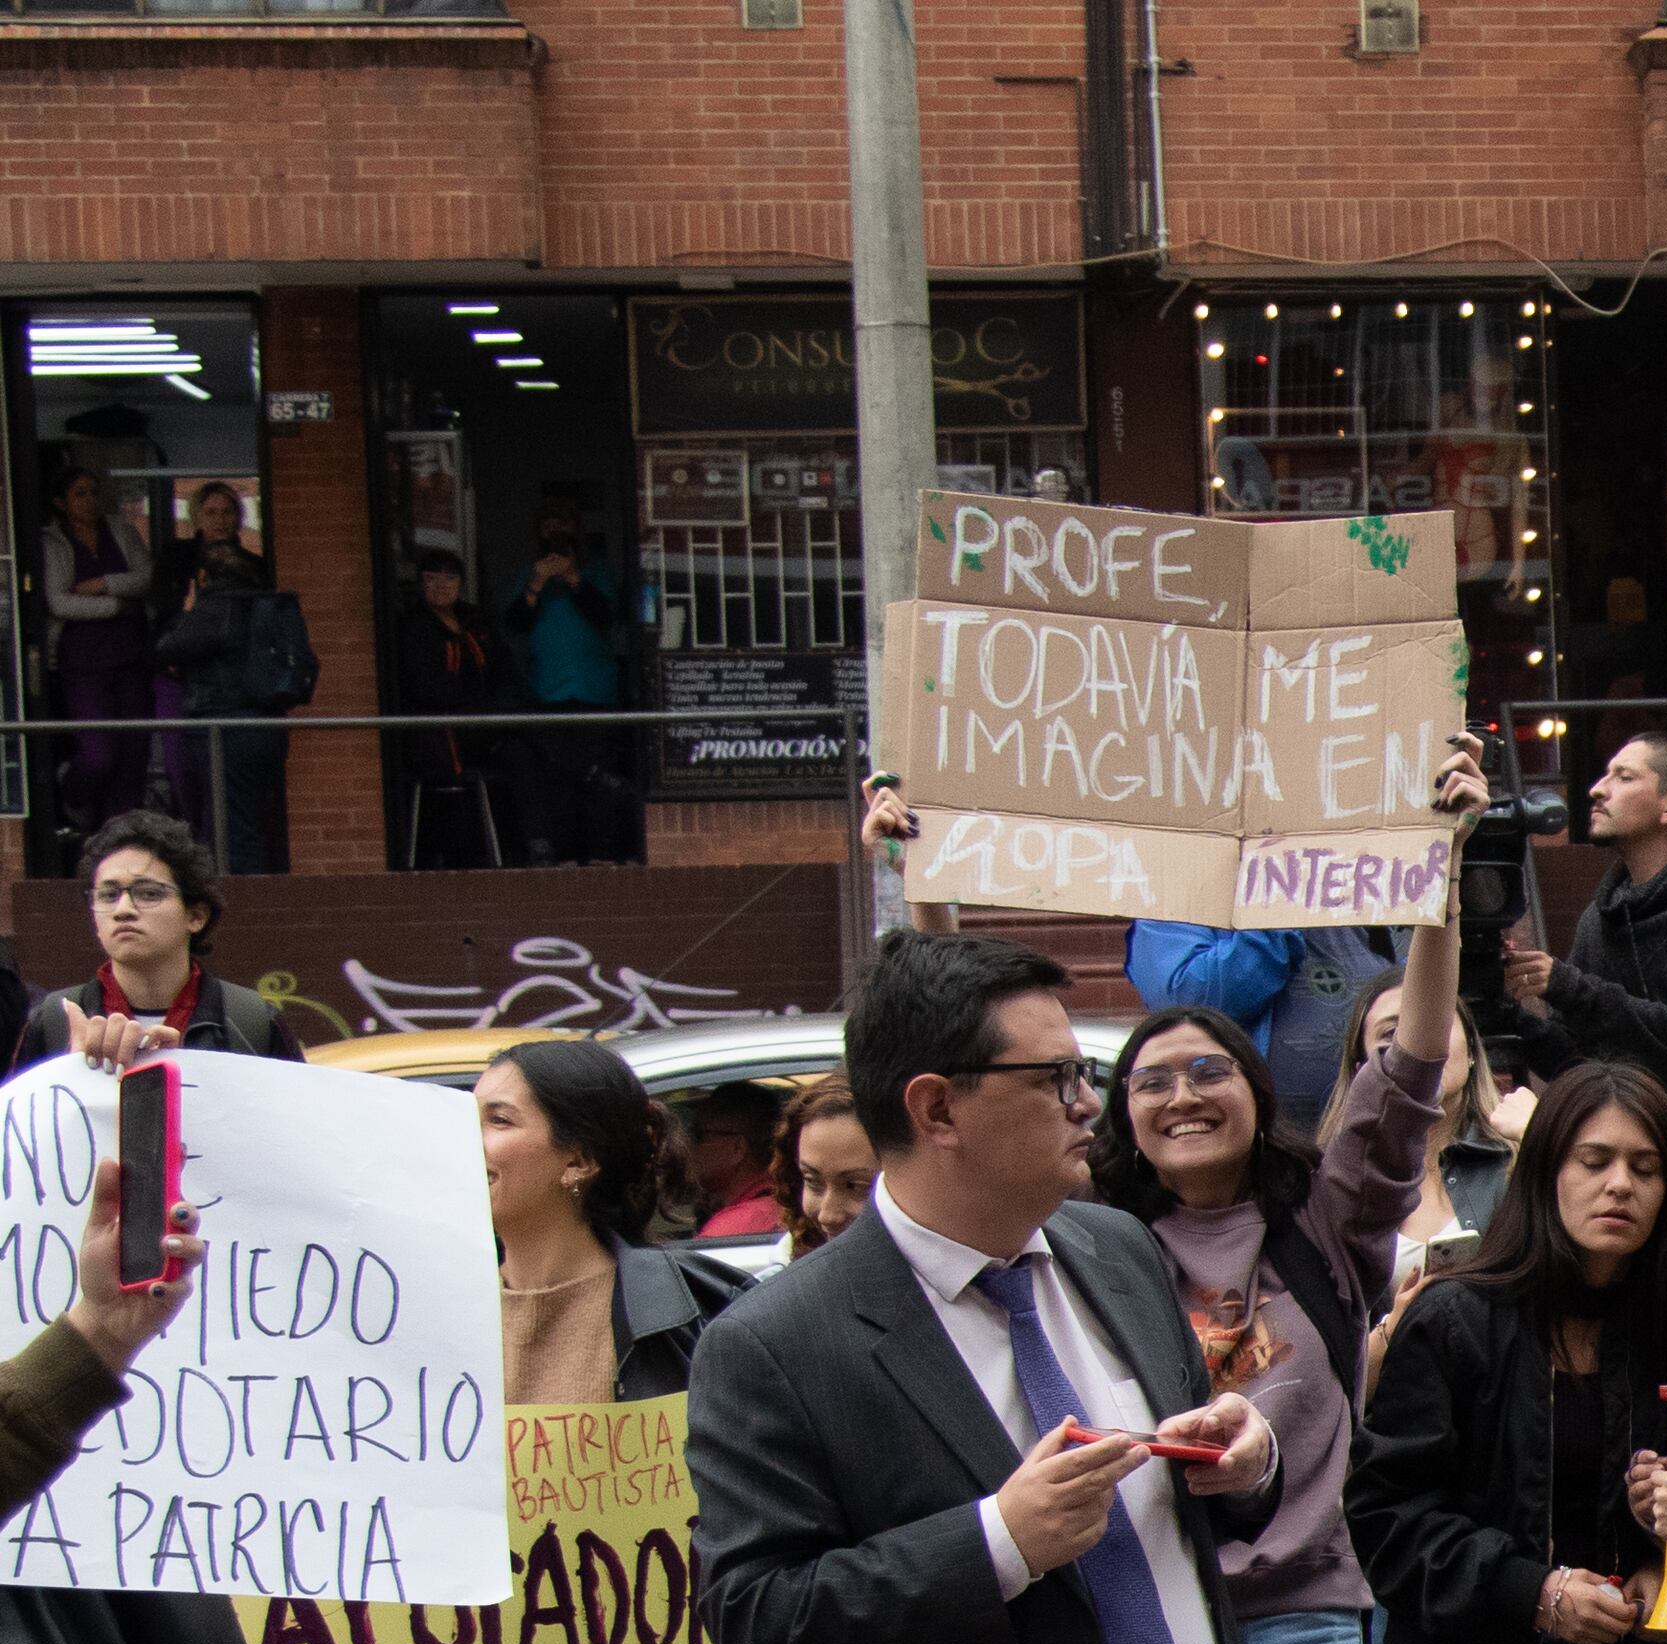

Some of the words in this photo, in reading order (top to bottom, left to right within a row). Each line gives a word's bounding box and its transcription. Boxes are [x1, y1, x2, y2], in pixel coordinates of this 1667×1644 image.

[919, 608, 1208, 741] TODAVÍA
[1258, 633, 1380, 725] ME
[689, 733, 847, 764] ¡PROMOCIÓN
[934, 703, 1285, 808] IMAGINA
[1316, 719, 1435, 821] EN
[85, 1365, 484, 1478] DOTARIO
[506, 1409, 677, 1481] PATRICIA
[107, 1481, 408, 1605] PATRICIA
[510, 1460, 686, 1525] BAUTISTA
